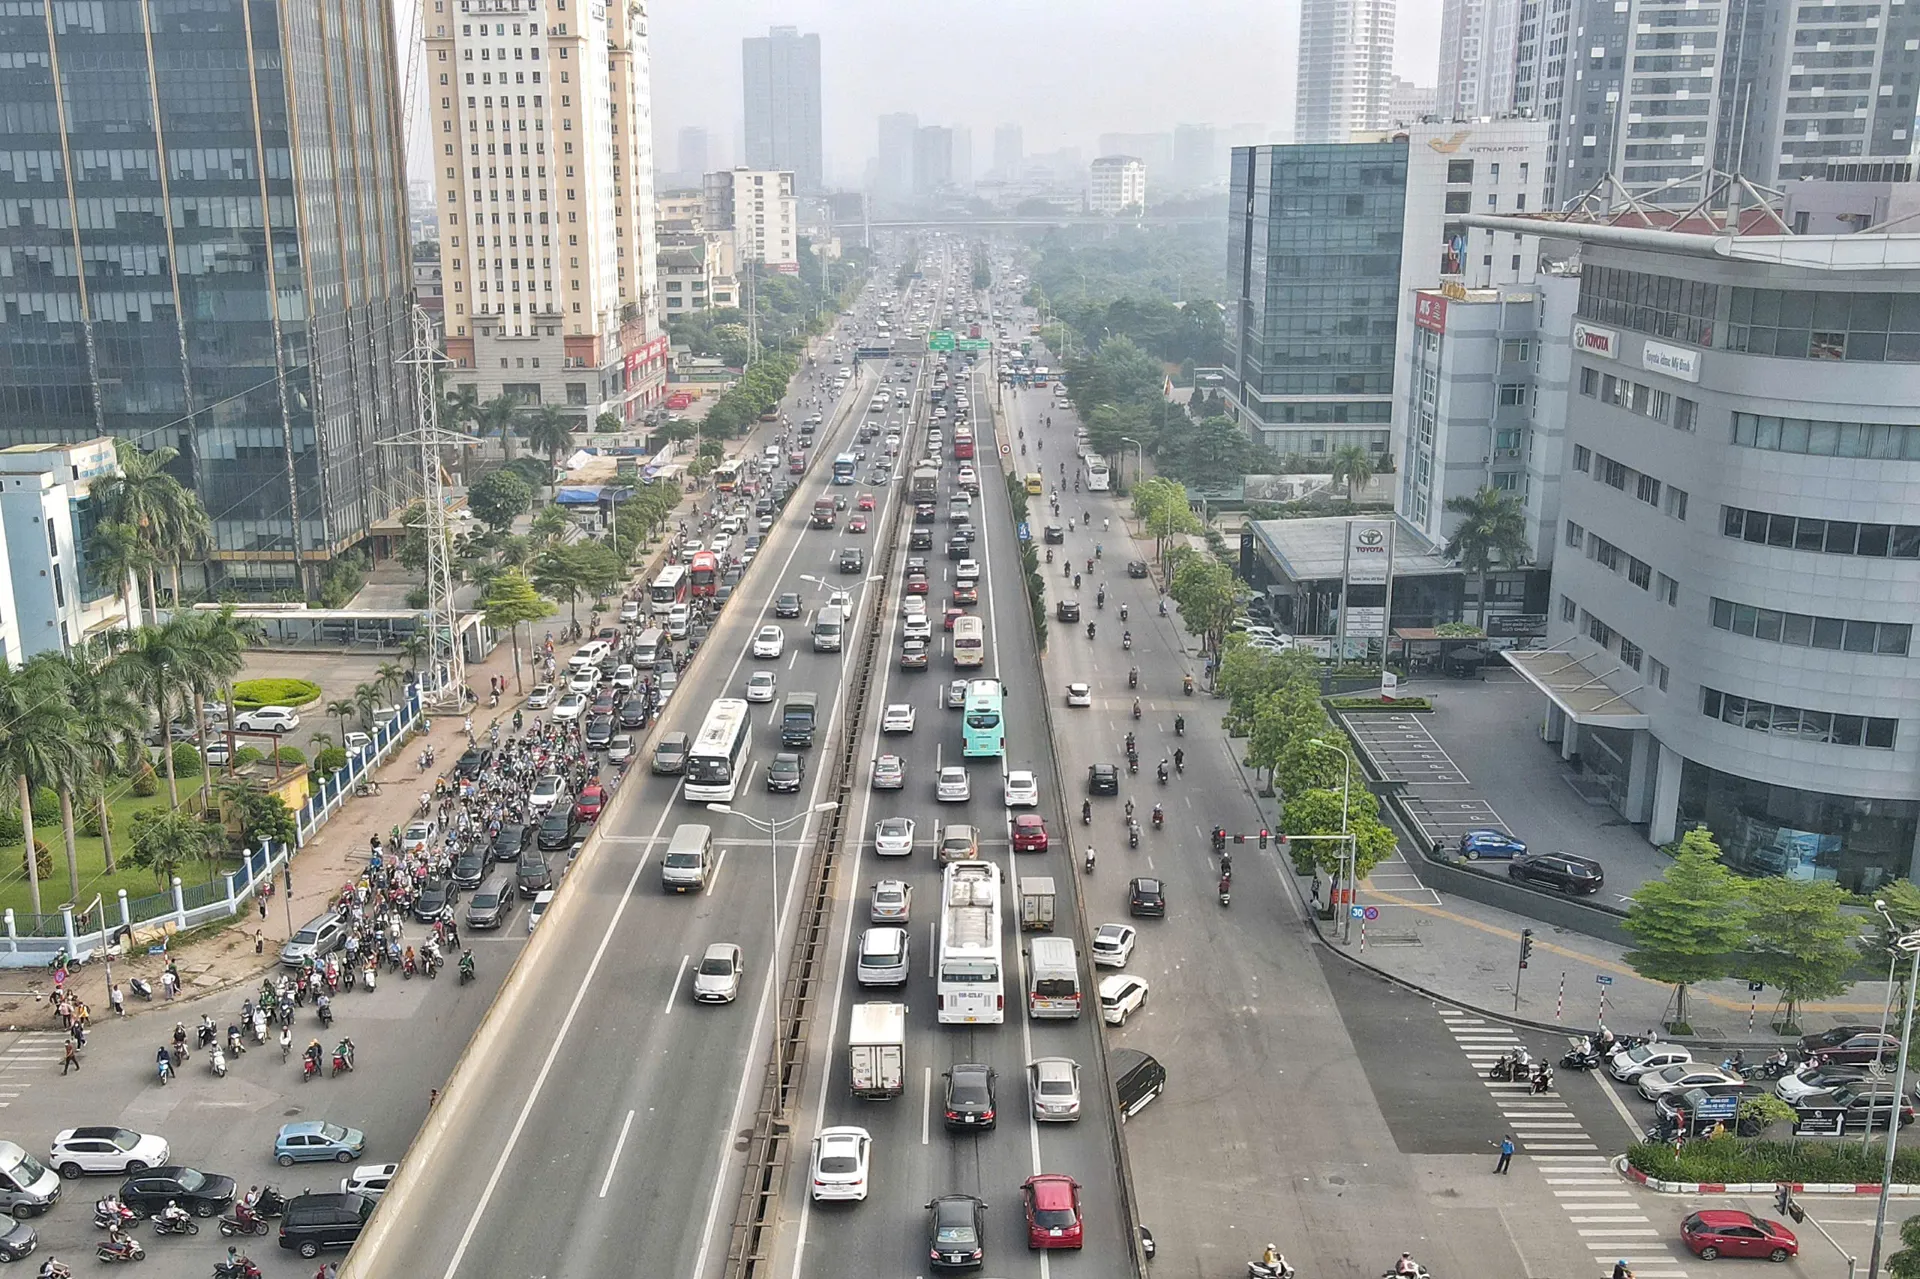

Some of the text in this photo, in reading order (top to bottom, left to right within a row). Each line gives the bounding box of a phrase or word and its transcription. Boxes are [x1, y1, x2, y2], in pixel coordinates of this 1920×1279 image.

[1585, 332, 1609, 351] TOYOTA
[1646, 349, 1660, 364] Toyota
[1352, 908, 1363, 917] 30
